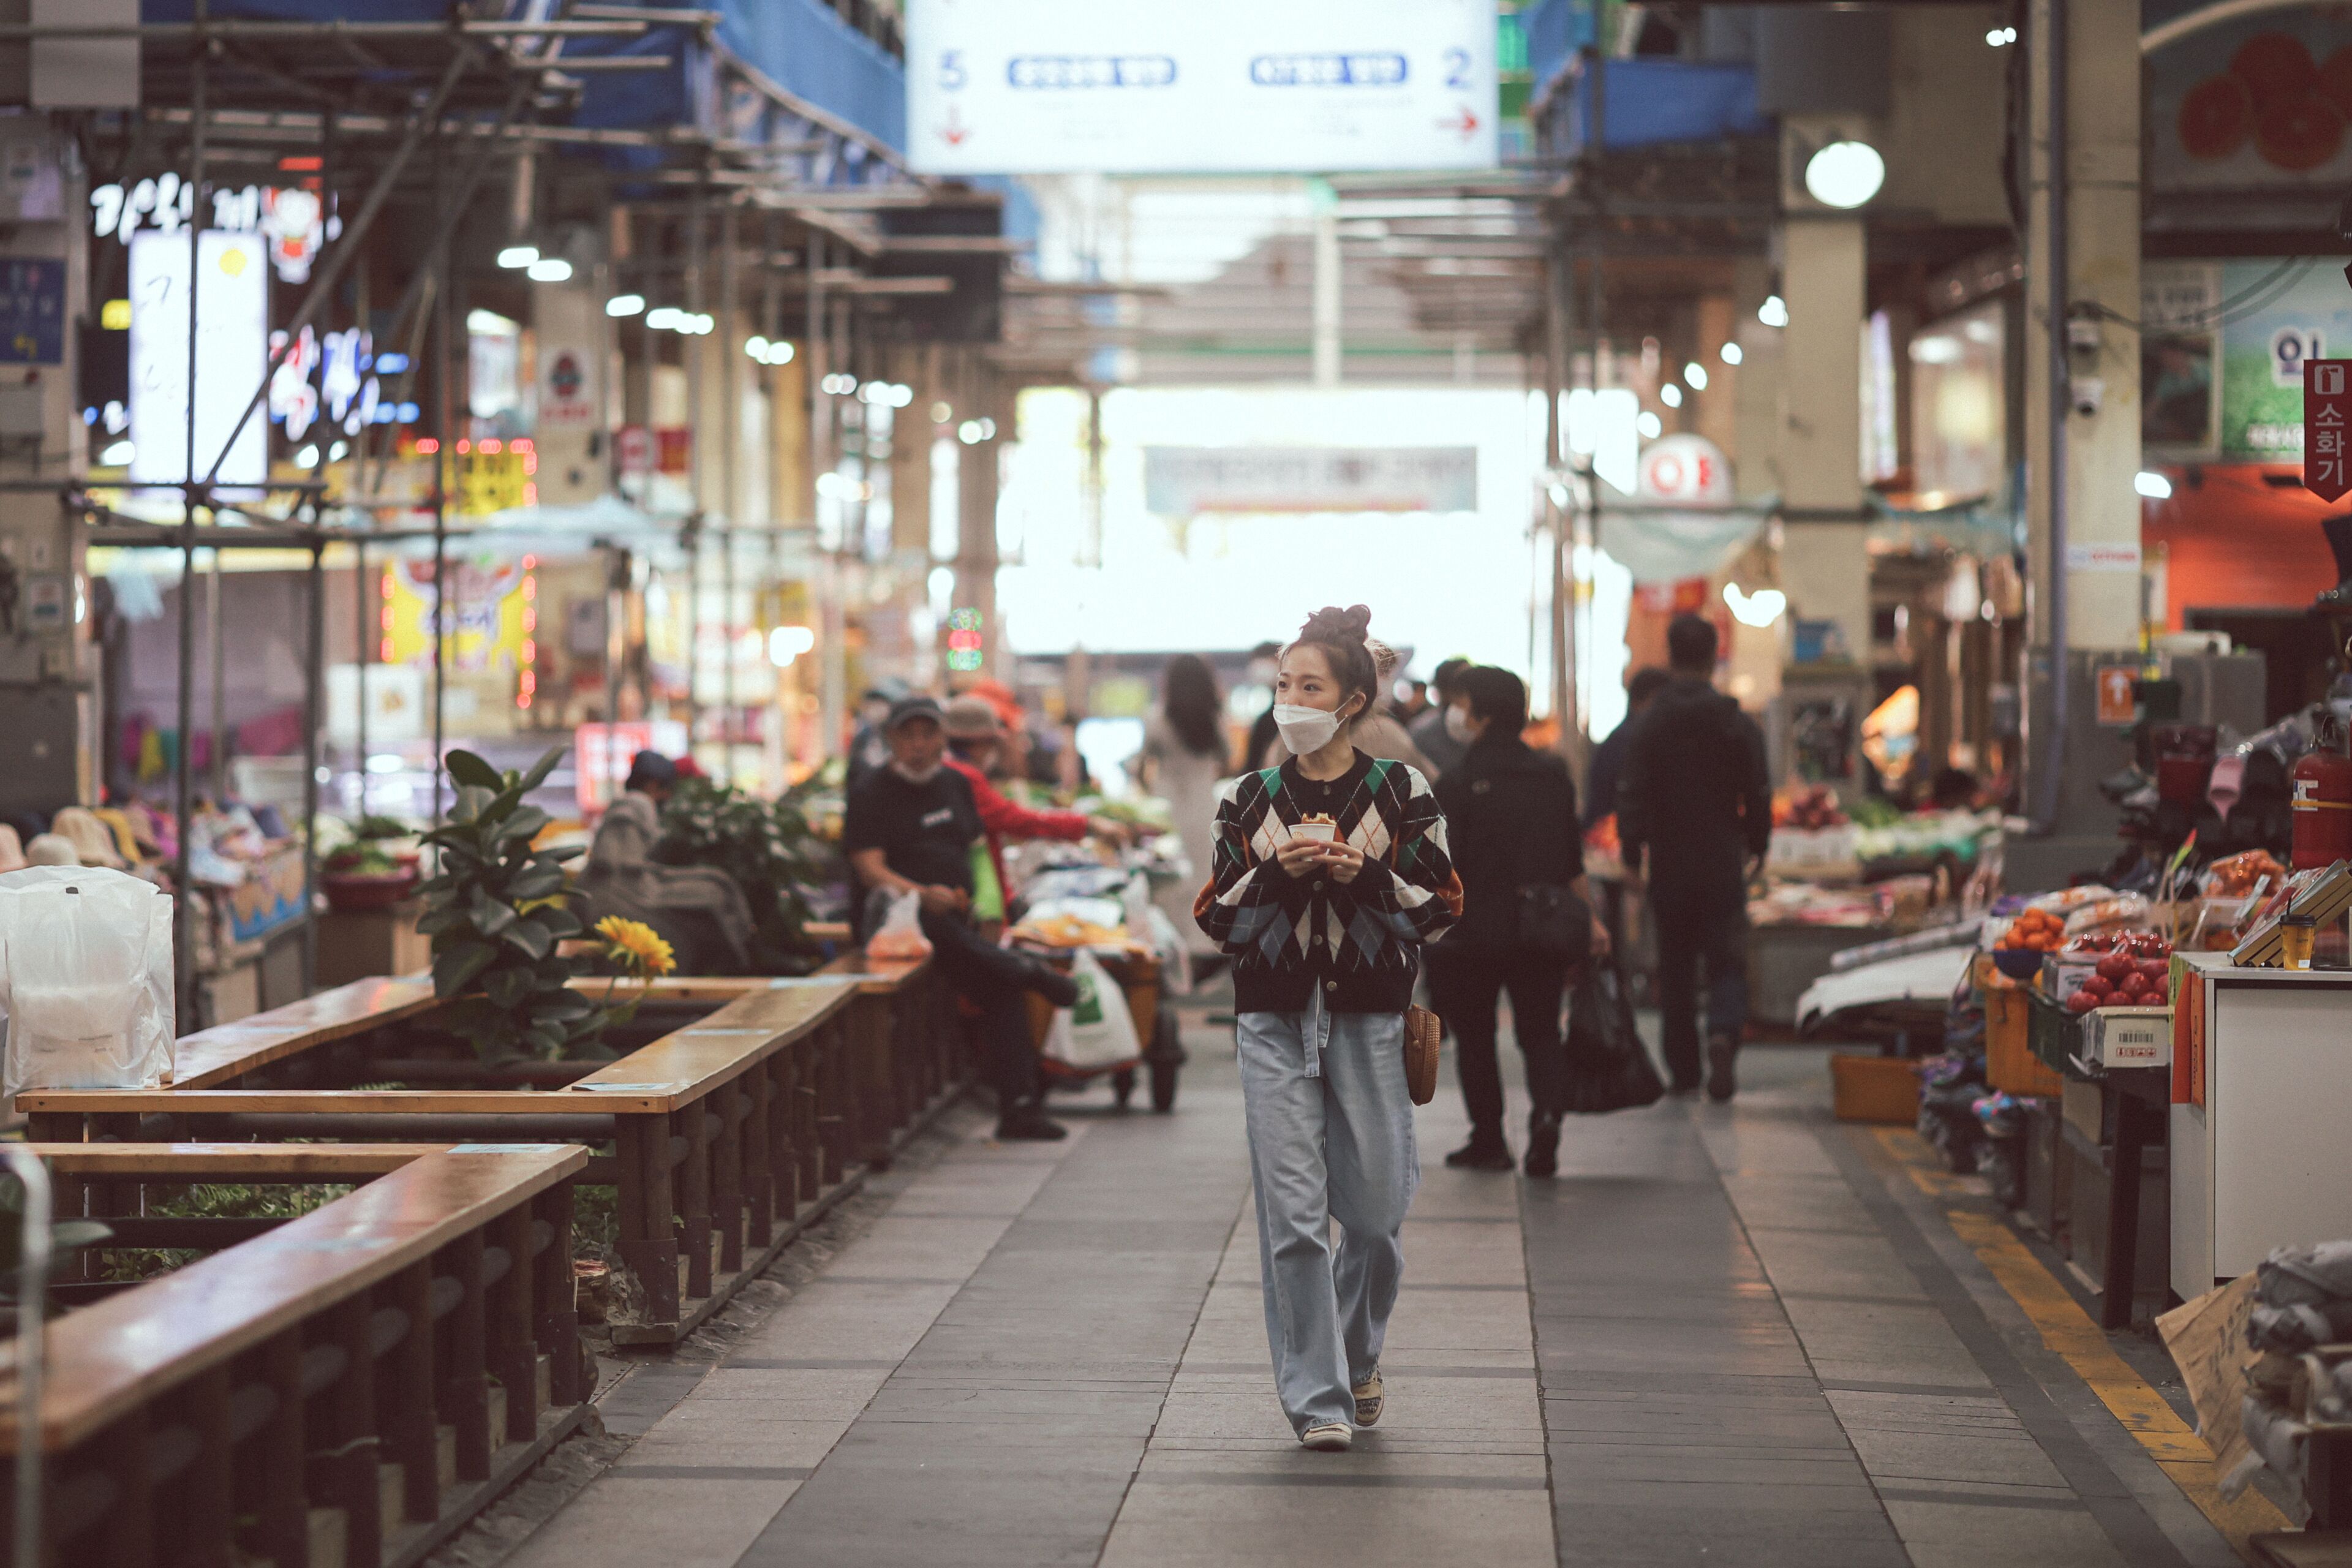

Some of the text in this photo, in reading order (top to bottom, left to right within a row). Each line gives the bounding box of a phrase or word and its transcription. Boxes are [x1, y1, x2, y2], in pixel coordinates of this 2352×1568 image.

[940, 50, 968, 91] 5
[1442, 47, 1471, 89] 2
[2315, 402, 2346, 486] 소화기
